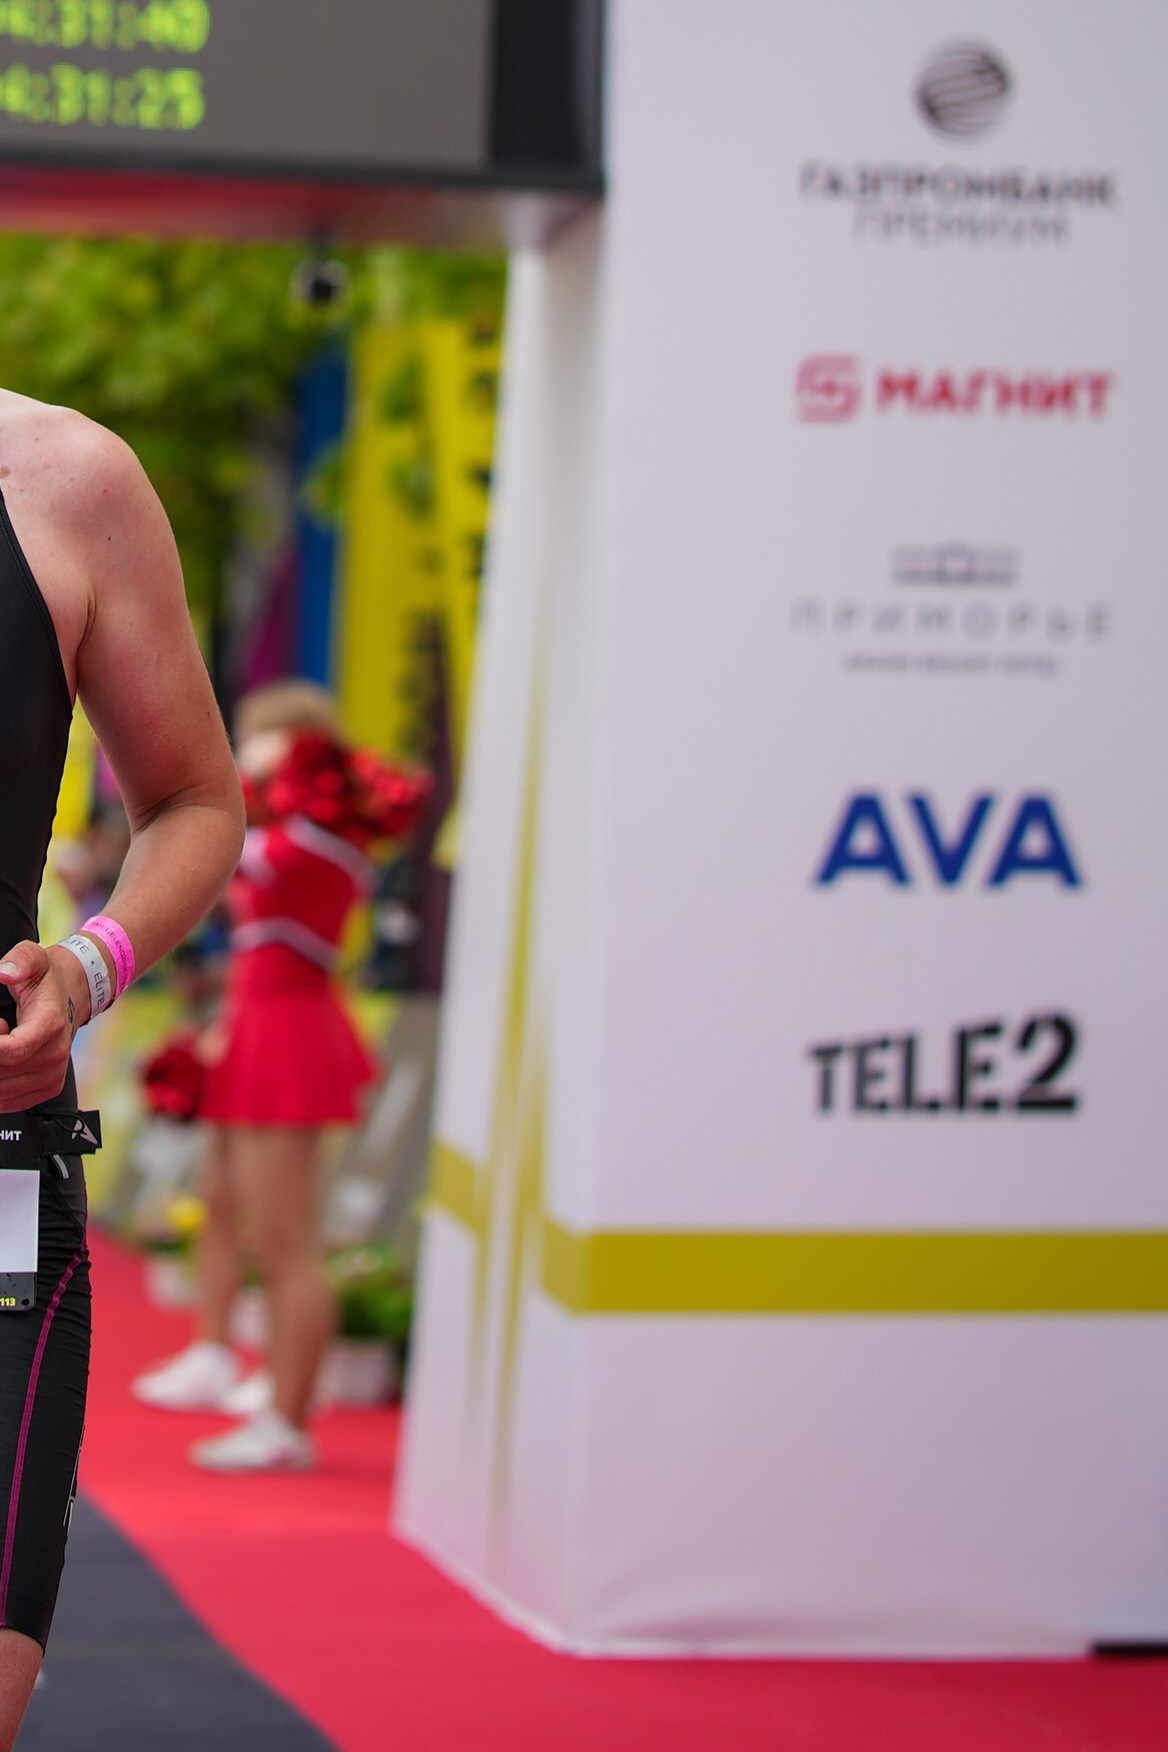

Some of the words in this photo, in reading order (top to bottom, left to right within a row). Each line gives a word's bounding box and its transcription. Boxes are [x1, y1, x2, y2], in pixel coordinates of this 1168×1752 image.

[875, 366, 1116, 419] МАГНИТ
[812, 789, 1084, 891] AVA
[93, 971, 105, 1008] ELITE
[806, 1010, 1082, 1116] TELE2
[0, 1297, 16, 1307] 113
